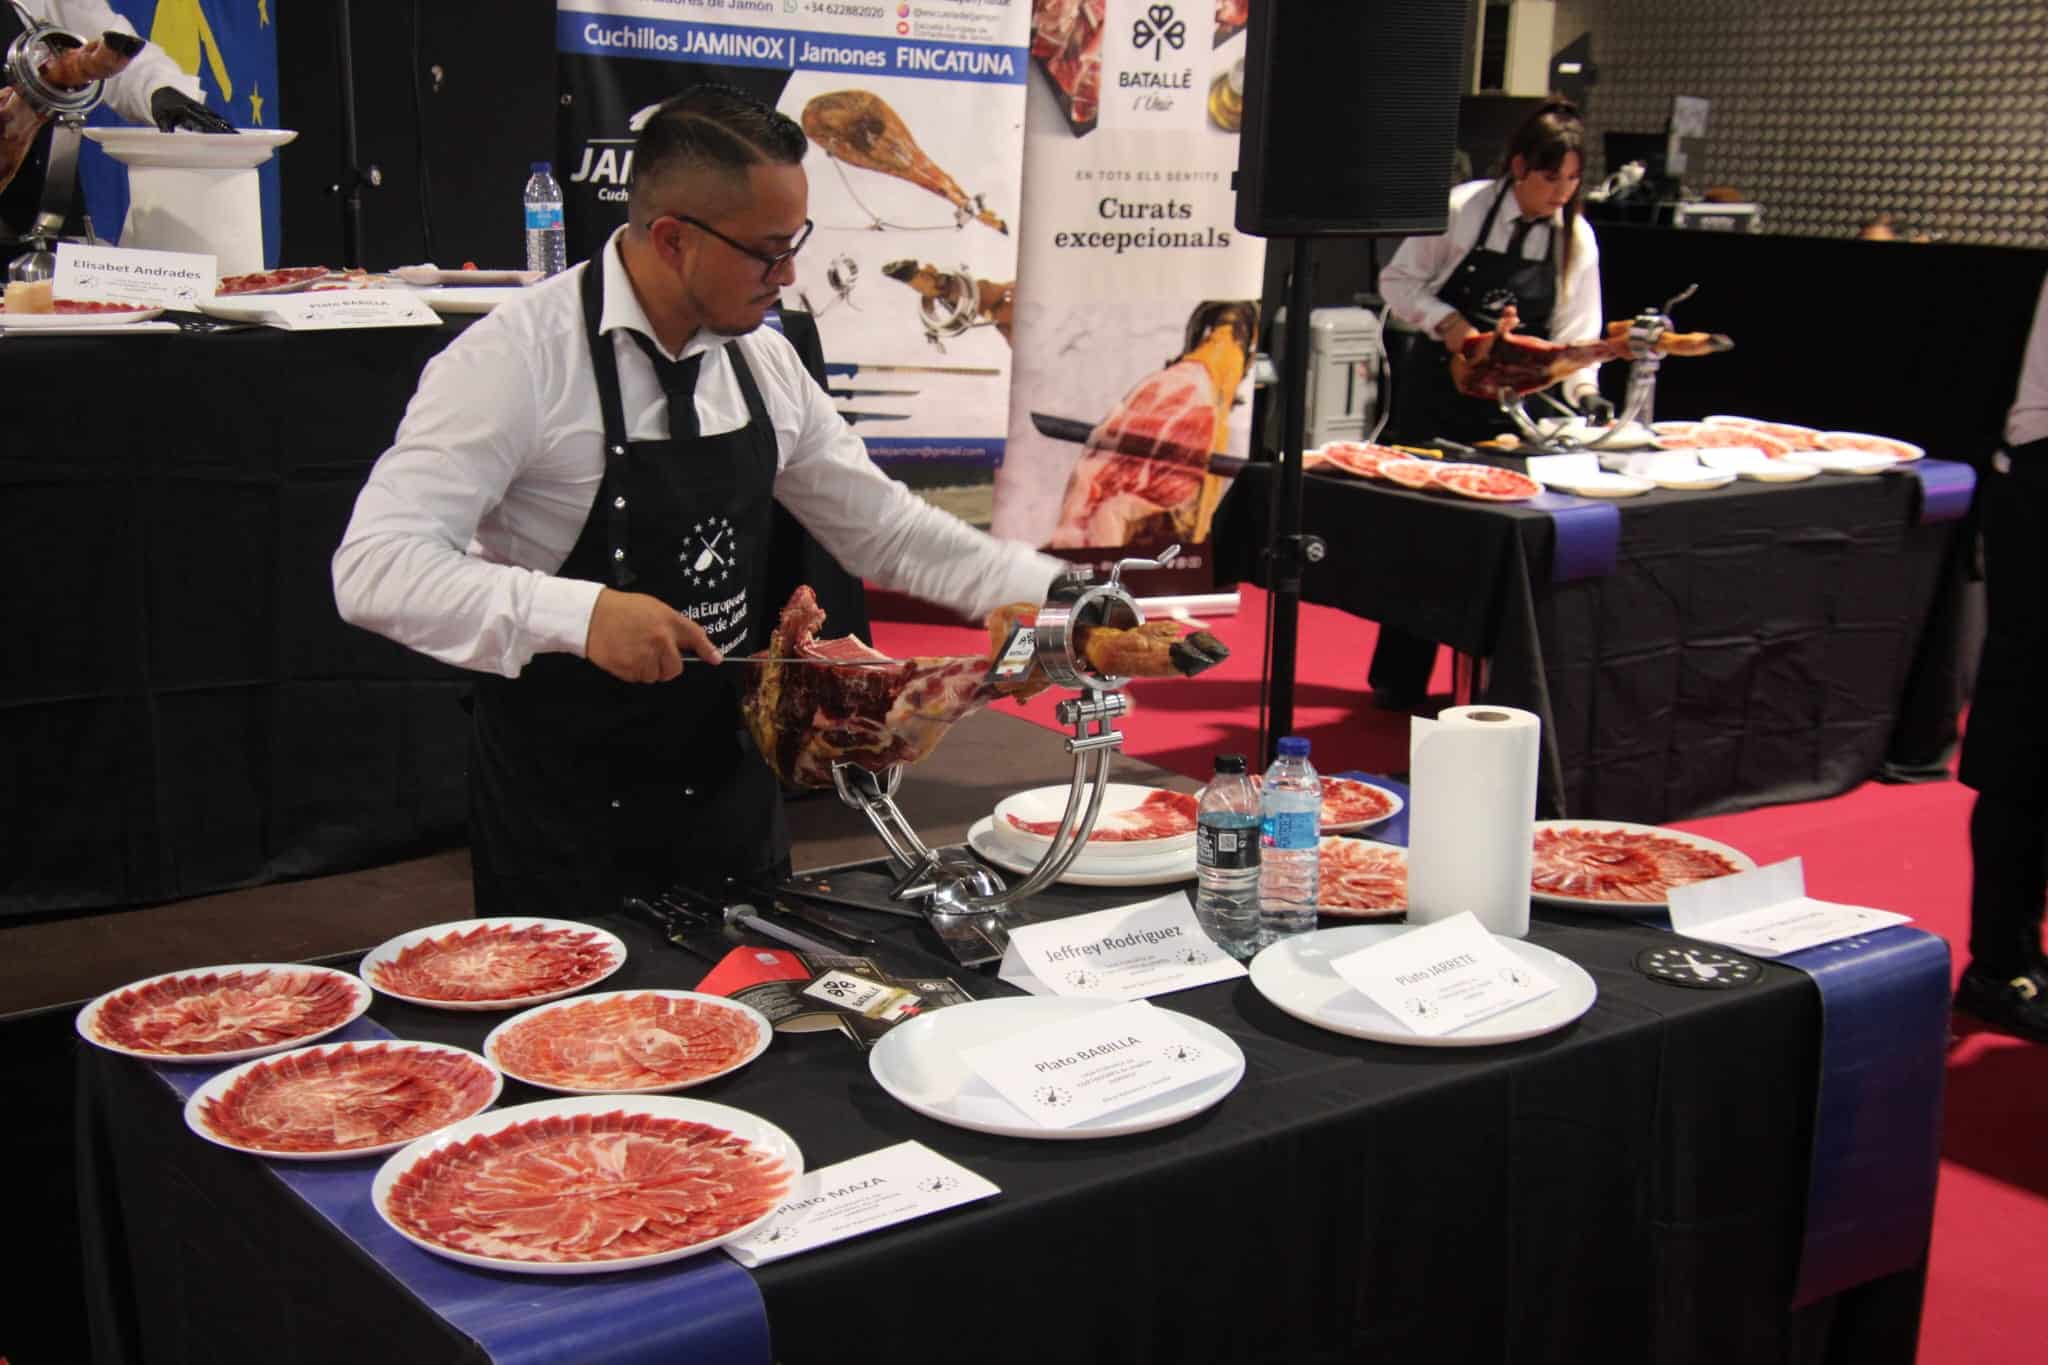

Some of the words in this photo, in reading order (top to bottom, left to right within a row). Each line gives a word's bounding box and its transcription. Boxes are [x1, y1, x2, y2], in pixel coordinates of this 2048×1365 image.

[583, 23, 678, 51] Cuchillos
[682, 30, 785, 59] JAMINOX
[800, 41, 887, 67] Jamones
[896, 47, 1015, 76] FINCATUNA
[1119, 67, 1192, 88] BATALLÉ
[1075, 170, 1093, 181] EN
[1099, 170, 1132, 181] TOTS
[1137, 171, 1161, 182] ELS
[1166, 171, 1219, 182] SENTITS
[598, 187, 630, 202] Cuch
[1099, 198, 1193, 219] Curats
[1054, 228, 1231, 253] excepcionals
[73, 259, 130, 273] Elisabet
[134, 263, 201, 279] Andrades
[1045, 941, 1102, 964] Jeffrey
[1394, 969, 1430, 987] Plato
[1429, 952, 1480, 978] JARRETE
[1034, 1054, 1077, 1074] Plato
[1075, 1035, 1142, 1062] BABILLA
[776, 1194, 826, 1216] Plato
[828, 1176, 889, 1200] MAZA
